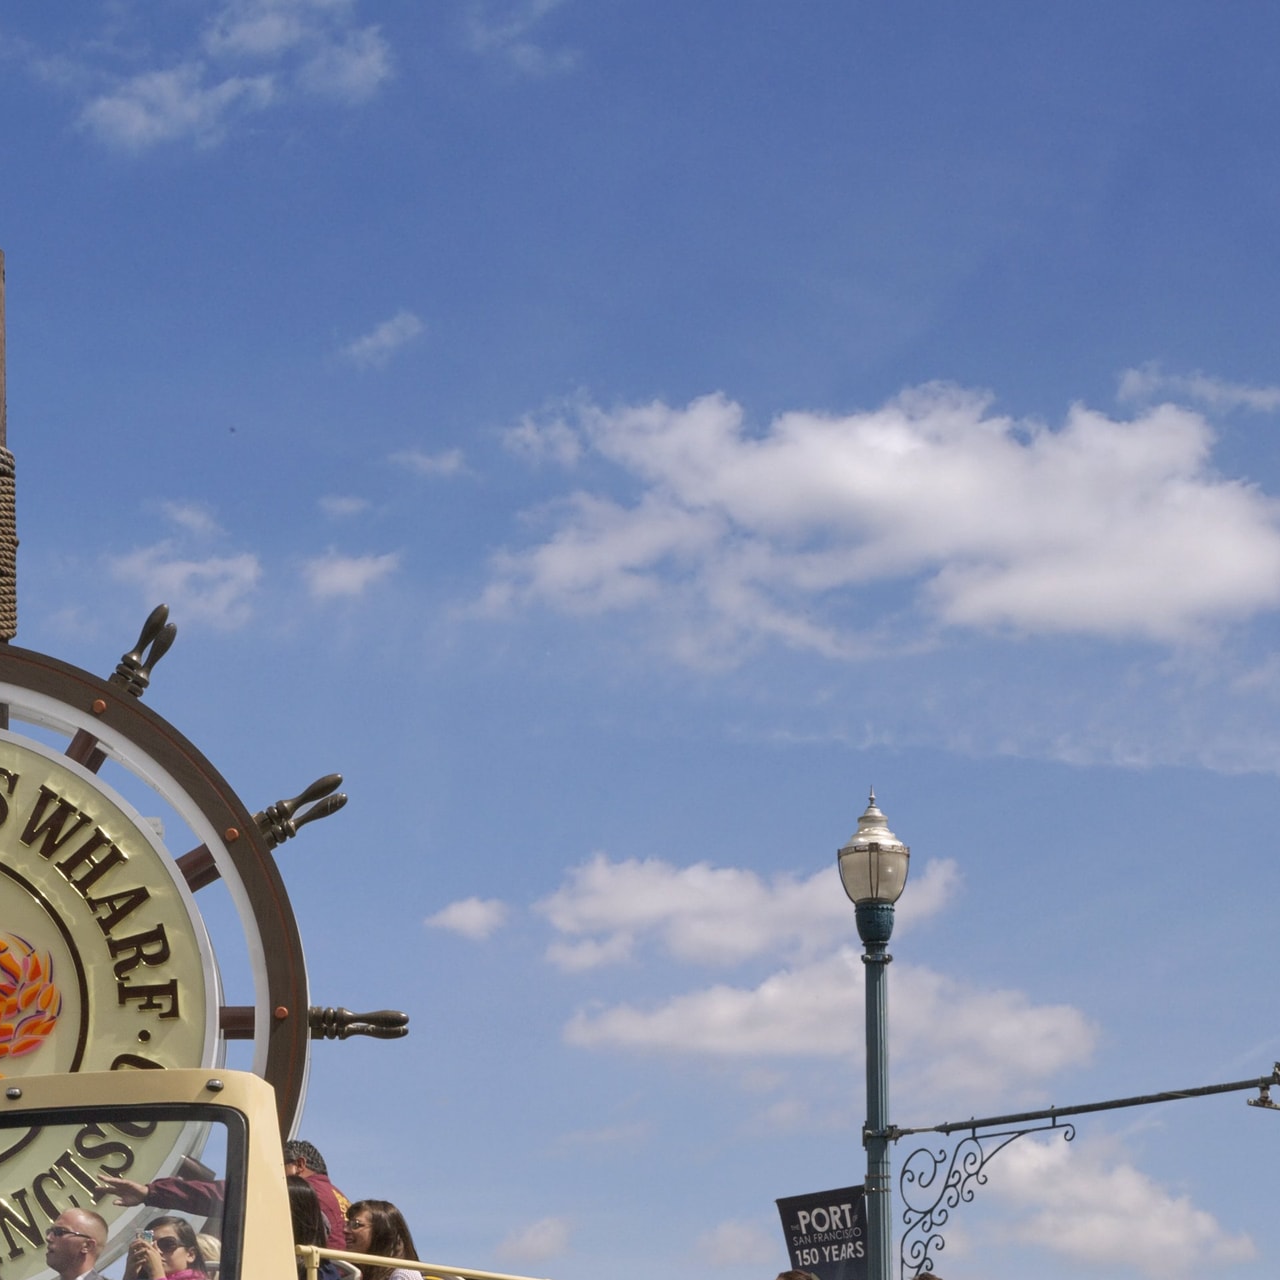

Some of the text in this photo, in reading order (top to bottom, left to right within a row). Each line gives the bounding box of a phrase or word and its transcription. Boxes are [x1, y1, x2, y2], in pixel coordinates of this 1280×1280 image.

[19, 784, 180, 1021] WHARF
[797, 1203, 852, 1235] PORT
[792, 1226, 862, 1247] SAN FRANCISCO
[795, 1241, 865, 1266] 150 YEARS
